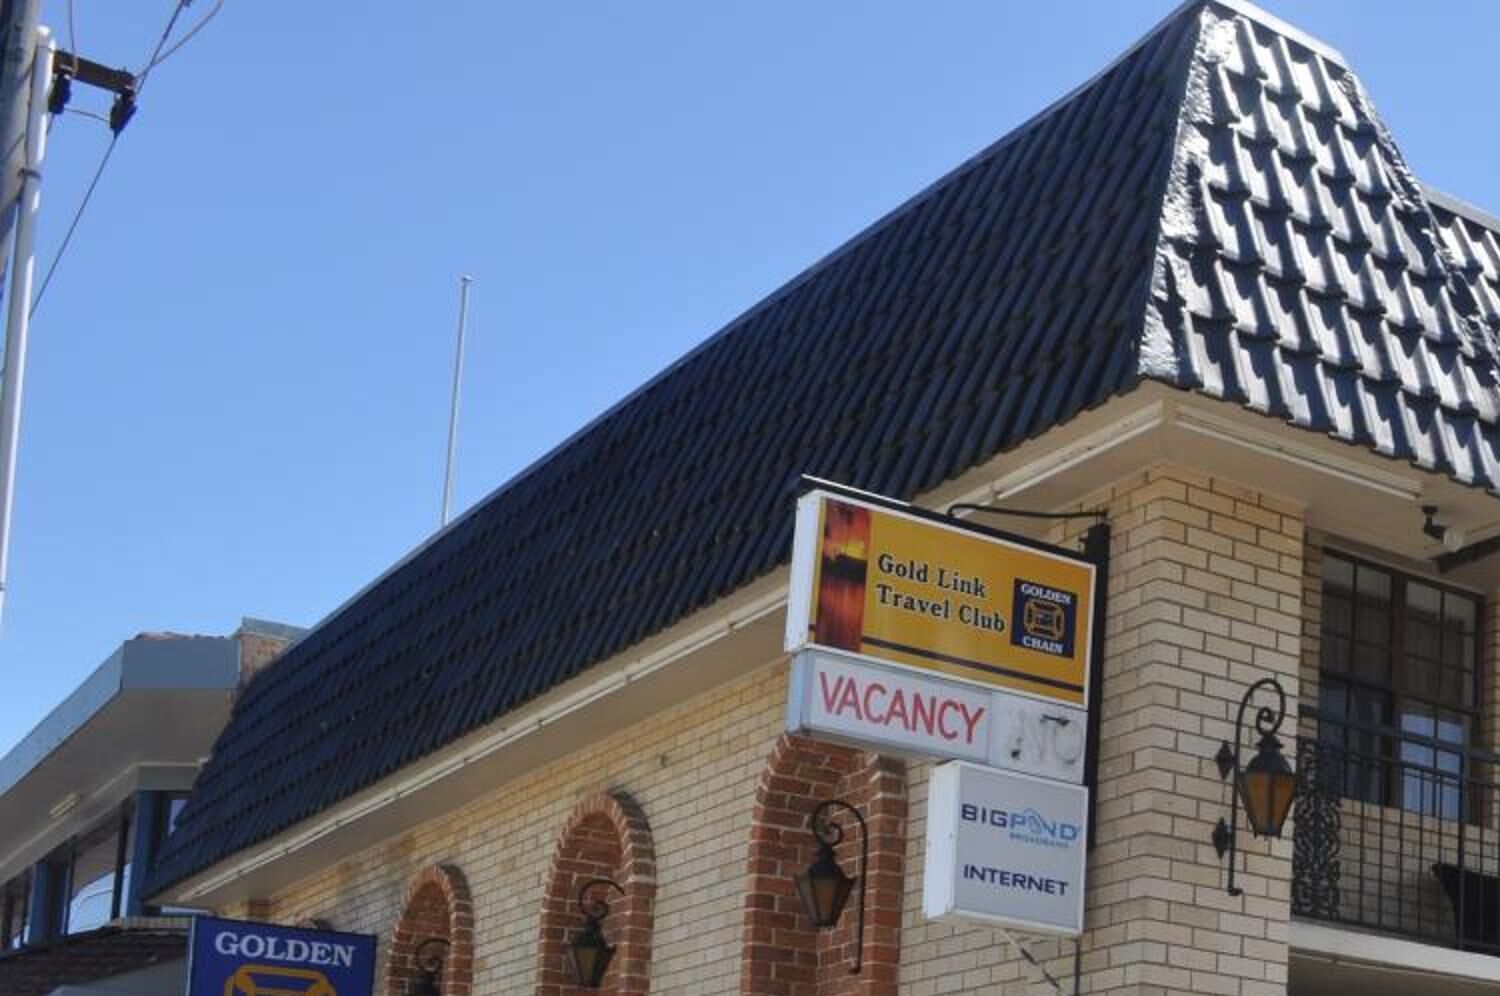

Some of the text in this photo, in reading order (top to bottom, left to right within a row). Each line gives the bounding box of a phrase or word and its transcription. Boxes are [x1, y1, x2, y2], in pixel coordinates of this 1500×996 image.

[878, 553, 986, 598] Gold Link
[876, 583, 1005, 632] Travel Club
[1020, 583, 1072, 605] GOLDEN
[1022, 634, 1064, 654] CHAIN
[819, 671, 985, 744] VACANCY
[963, 864, 1069, 896] INTERNET
[215, 931, 356, 967] GOLDEN
